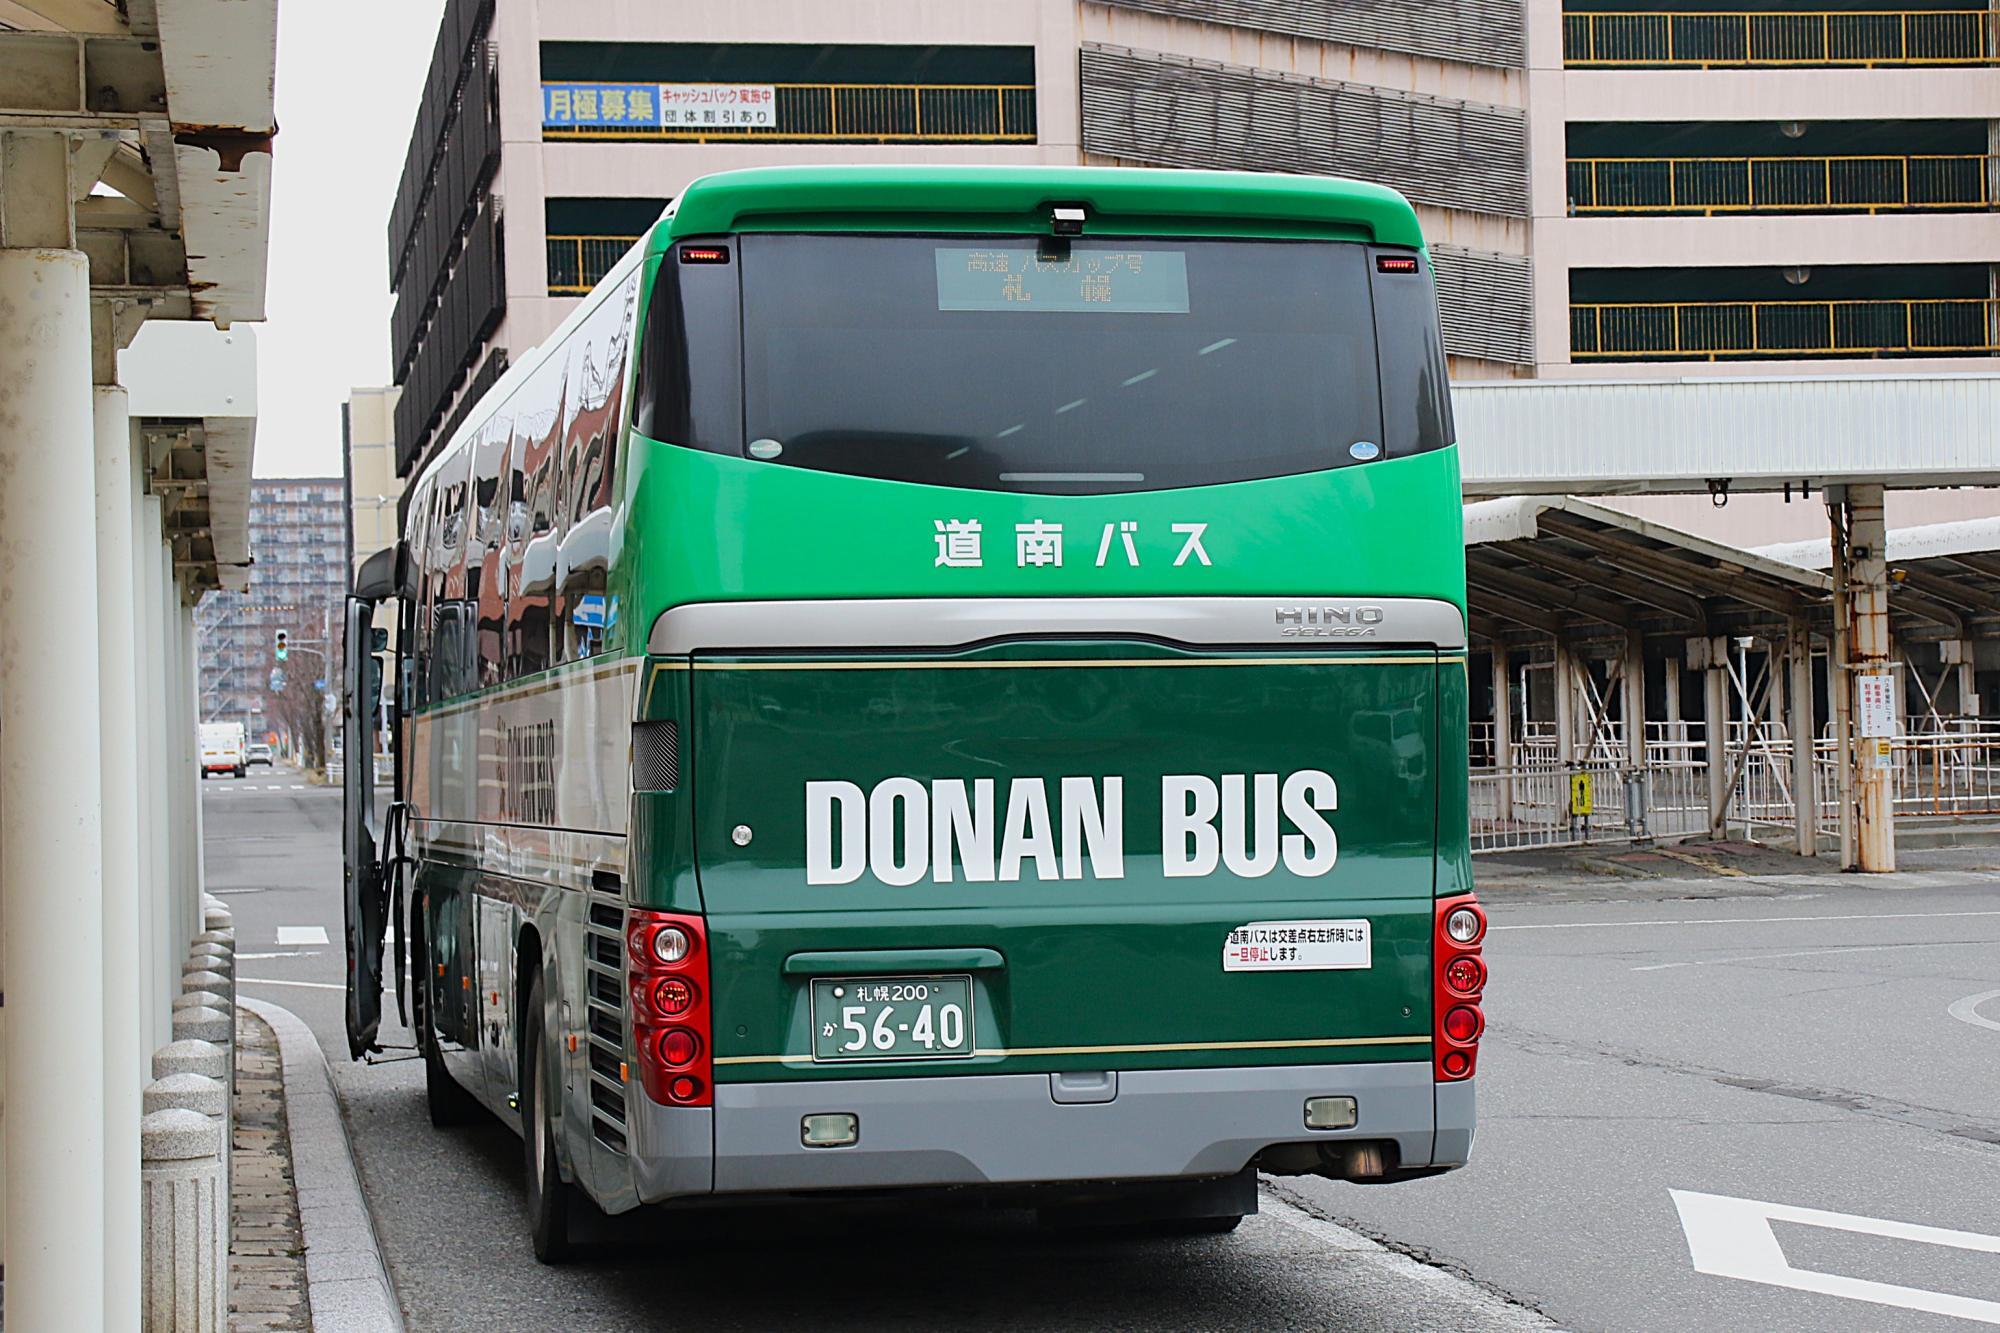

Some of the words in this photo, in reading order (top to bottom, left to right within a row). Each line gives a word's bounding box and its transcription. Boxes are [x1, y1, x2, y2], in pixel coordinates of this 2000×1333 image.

[549, 89, 653, 121] 月極募集
[662, 88, 772, 104] キャッシュバック実施中
[665, 109, 767, 124] 団体割引あり
[934, 519, 1212, 567] 道南バス
[1275, 606, 1383, 625] HINO
[1280, 626, 1377, 637] SELEGA
[805, 776, 1125, 887] DONAN
[1161, 769, 1338, 879] BUS
[1230, 928, 1364, 945] 道南バスは交差点右左折時には
[1230, 946, 1303, 962] 一旦停止します。
[822, 1022, 838, 1038] か
[842, 1003, 964, 1051] 56-40
